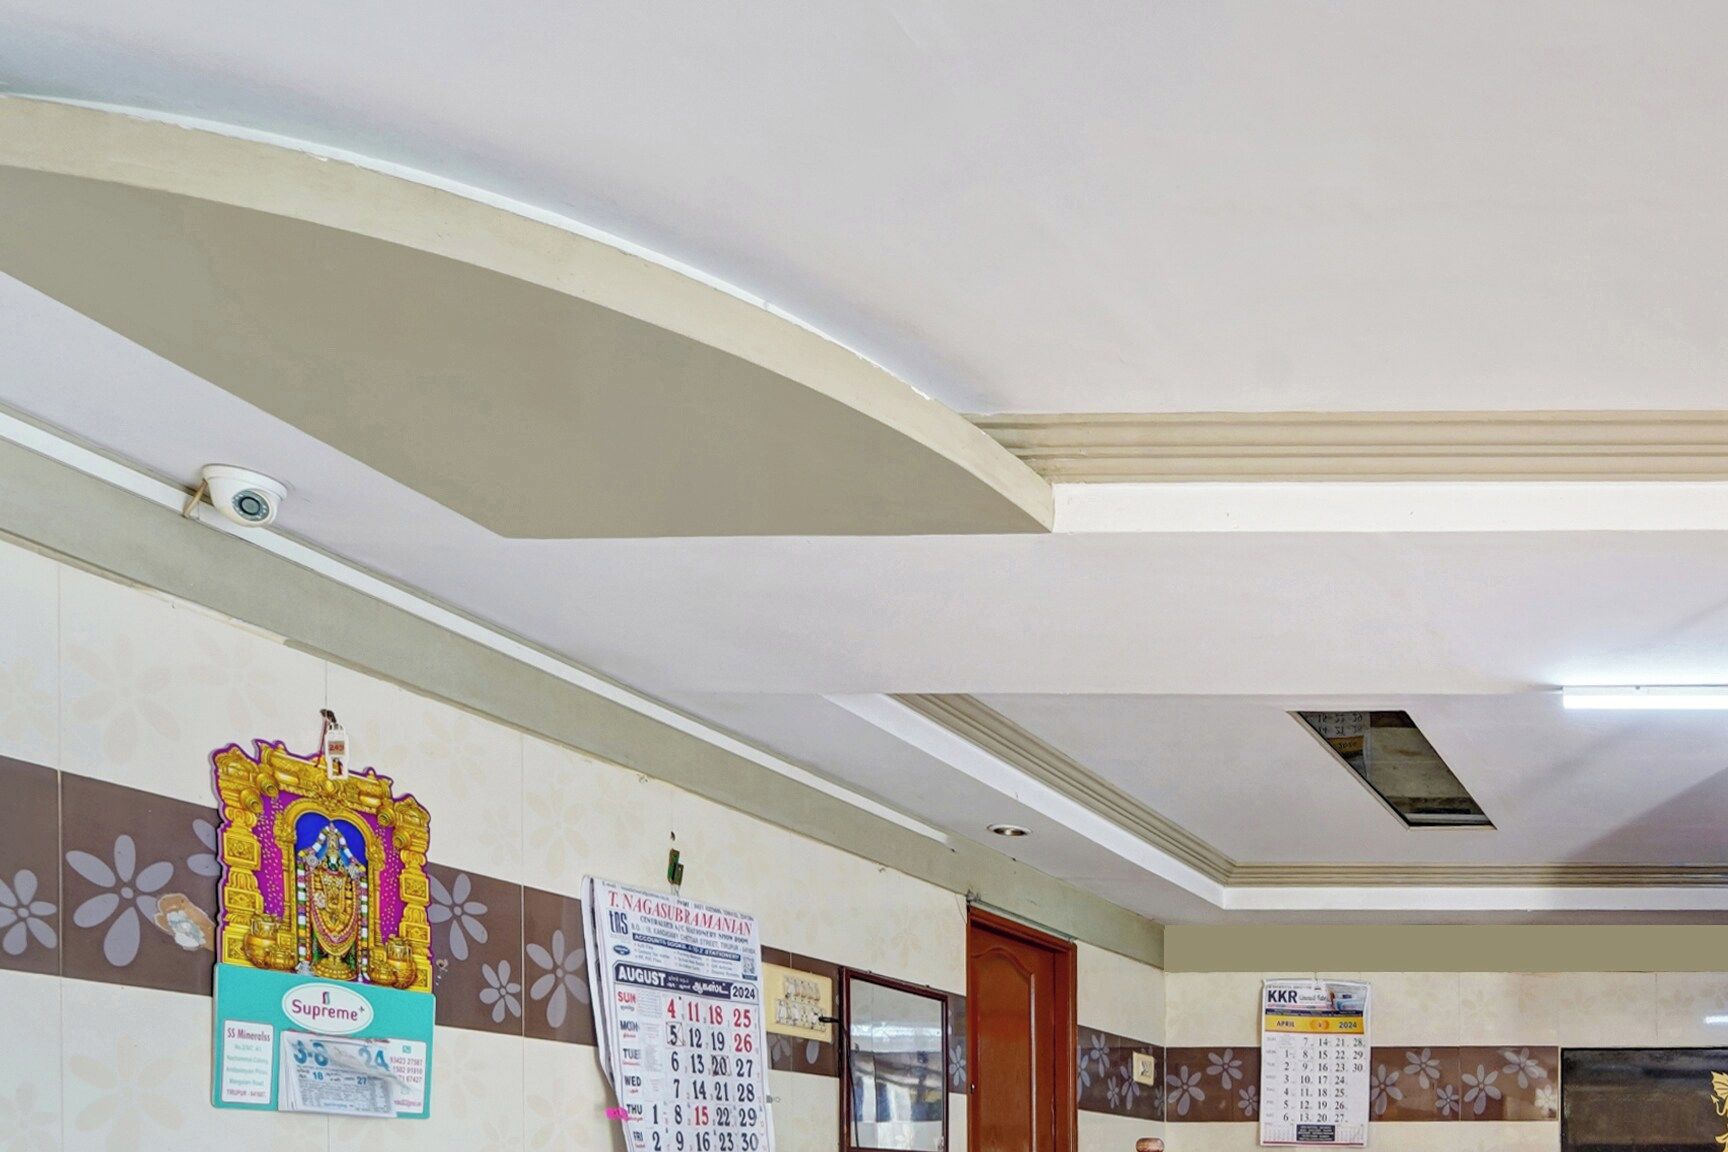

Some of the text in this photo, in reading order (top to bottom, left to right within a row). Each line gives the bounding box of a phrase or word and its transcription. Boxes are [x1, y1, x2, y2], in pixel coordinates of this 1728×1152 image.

[608, 890, 619, 908] T.
[622, 892, 752, 936] NAGASUBRAMANIAN
[618, 966, 666, 986] AUGUST
[732, 986, 756, 1000] 2024
[1268, 990, 1298, 1003] KKR
[292, 999, 358, 1022] Supreme
[668, 998, 676, 1019] 4
[688, 1001, 700, 1023] 11
[709, 1005, 723, 1025] 18
[734, 1008, 752, 1028] 25
[1276, 1020, 1295, 1028] APRIL
[227, 1028, 236, 1038] SS
[670, 1025, 678, 1046] 5
[689, 1028, 702, 1048] 12
[712, 1032, 725, 1051] 19
[734, 1033, 752, 1053] 26
[1319, 1038, 1328, 1046] 14
[1336, 1038, 1344, 1047] 21
[1353, 1038, 1362, 1047] 28
[1319, 1050, 1328, 1059] 15
[1336, 1050, 1345, 1059] 22
[1353, 1050, 1363, 1060] 29
[622, 1048, 753, 1078] TUE 6 13 20 27
[1318, 1063, 1328, 1072] 16
[1336, 1063, 1345, 1072] 23
[1352, 1064, 1363, 1072] 30
[313, 1072, 324, 1080] 18
[356, 1076, 366, 1085] 27
[1300, 1076, 1310, 1084] 10
[1318, 1076, 1328, 1084] 17
[1335, 1076, 1345, 1085] 24
[624, 1076, 754, 1102] WED 7 14 21 28
[1300, 1088, 1309, 1096] 11
[1318, 1089, 1328, 1097] 18
[1335, 1088, 1344, 1098] 25
[1300, 1100, 1310, 1109] 12
[1335, 1101, 1344, 1110] 26
[627, 1104, 758, 1128] THU 1 8 15 22 29
[1300, 1114, 1309, 1122] 13
[1317, 1114, 1328, 1122] 20
[1335, 1114, 1344, 1122] 27
[634, 1131, 759, 1152] FRI 2 9 16 23 30
